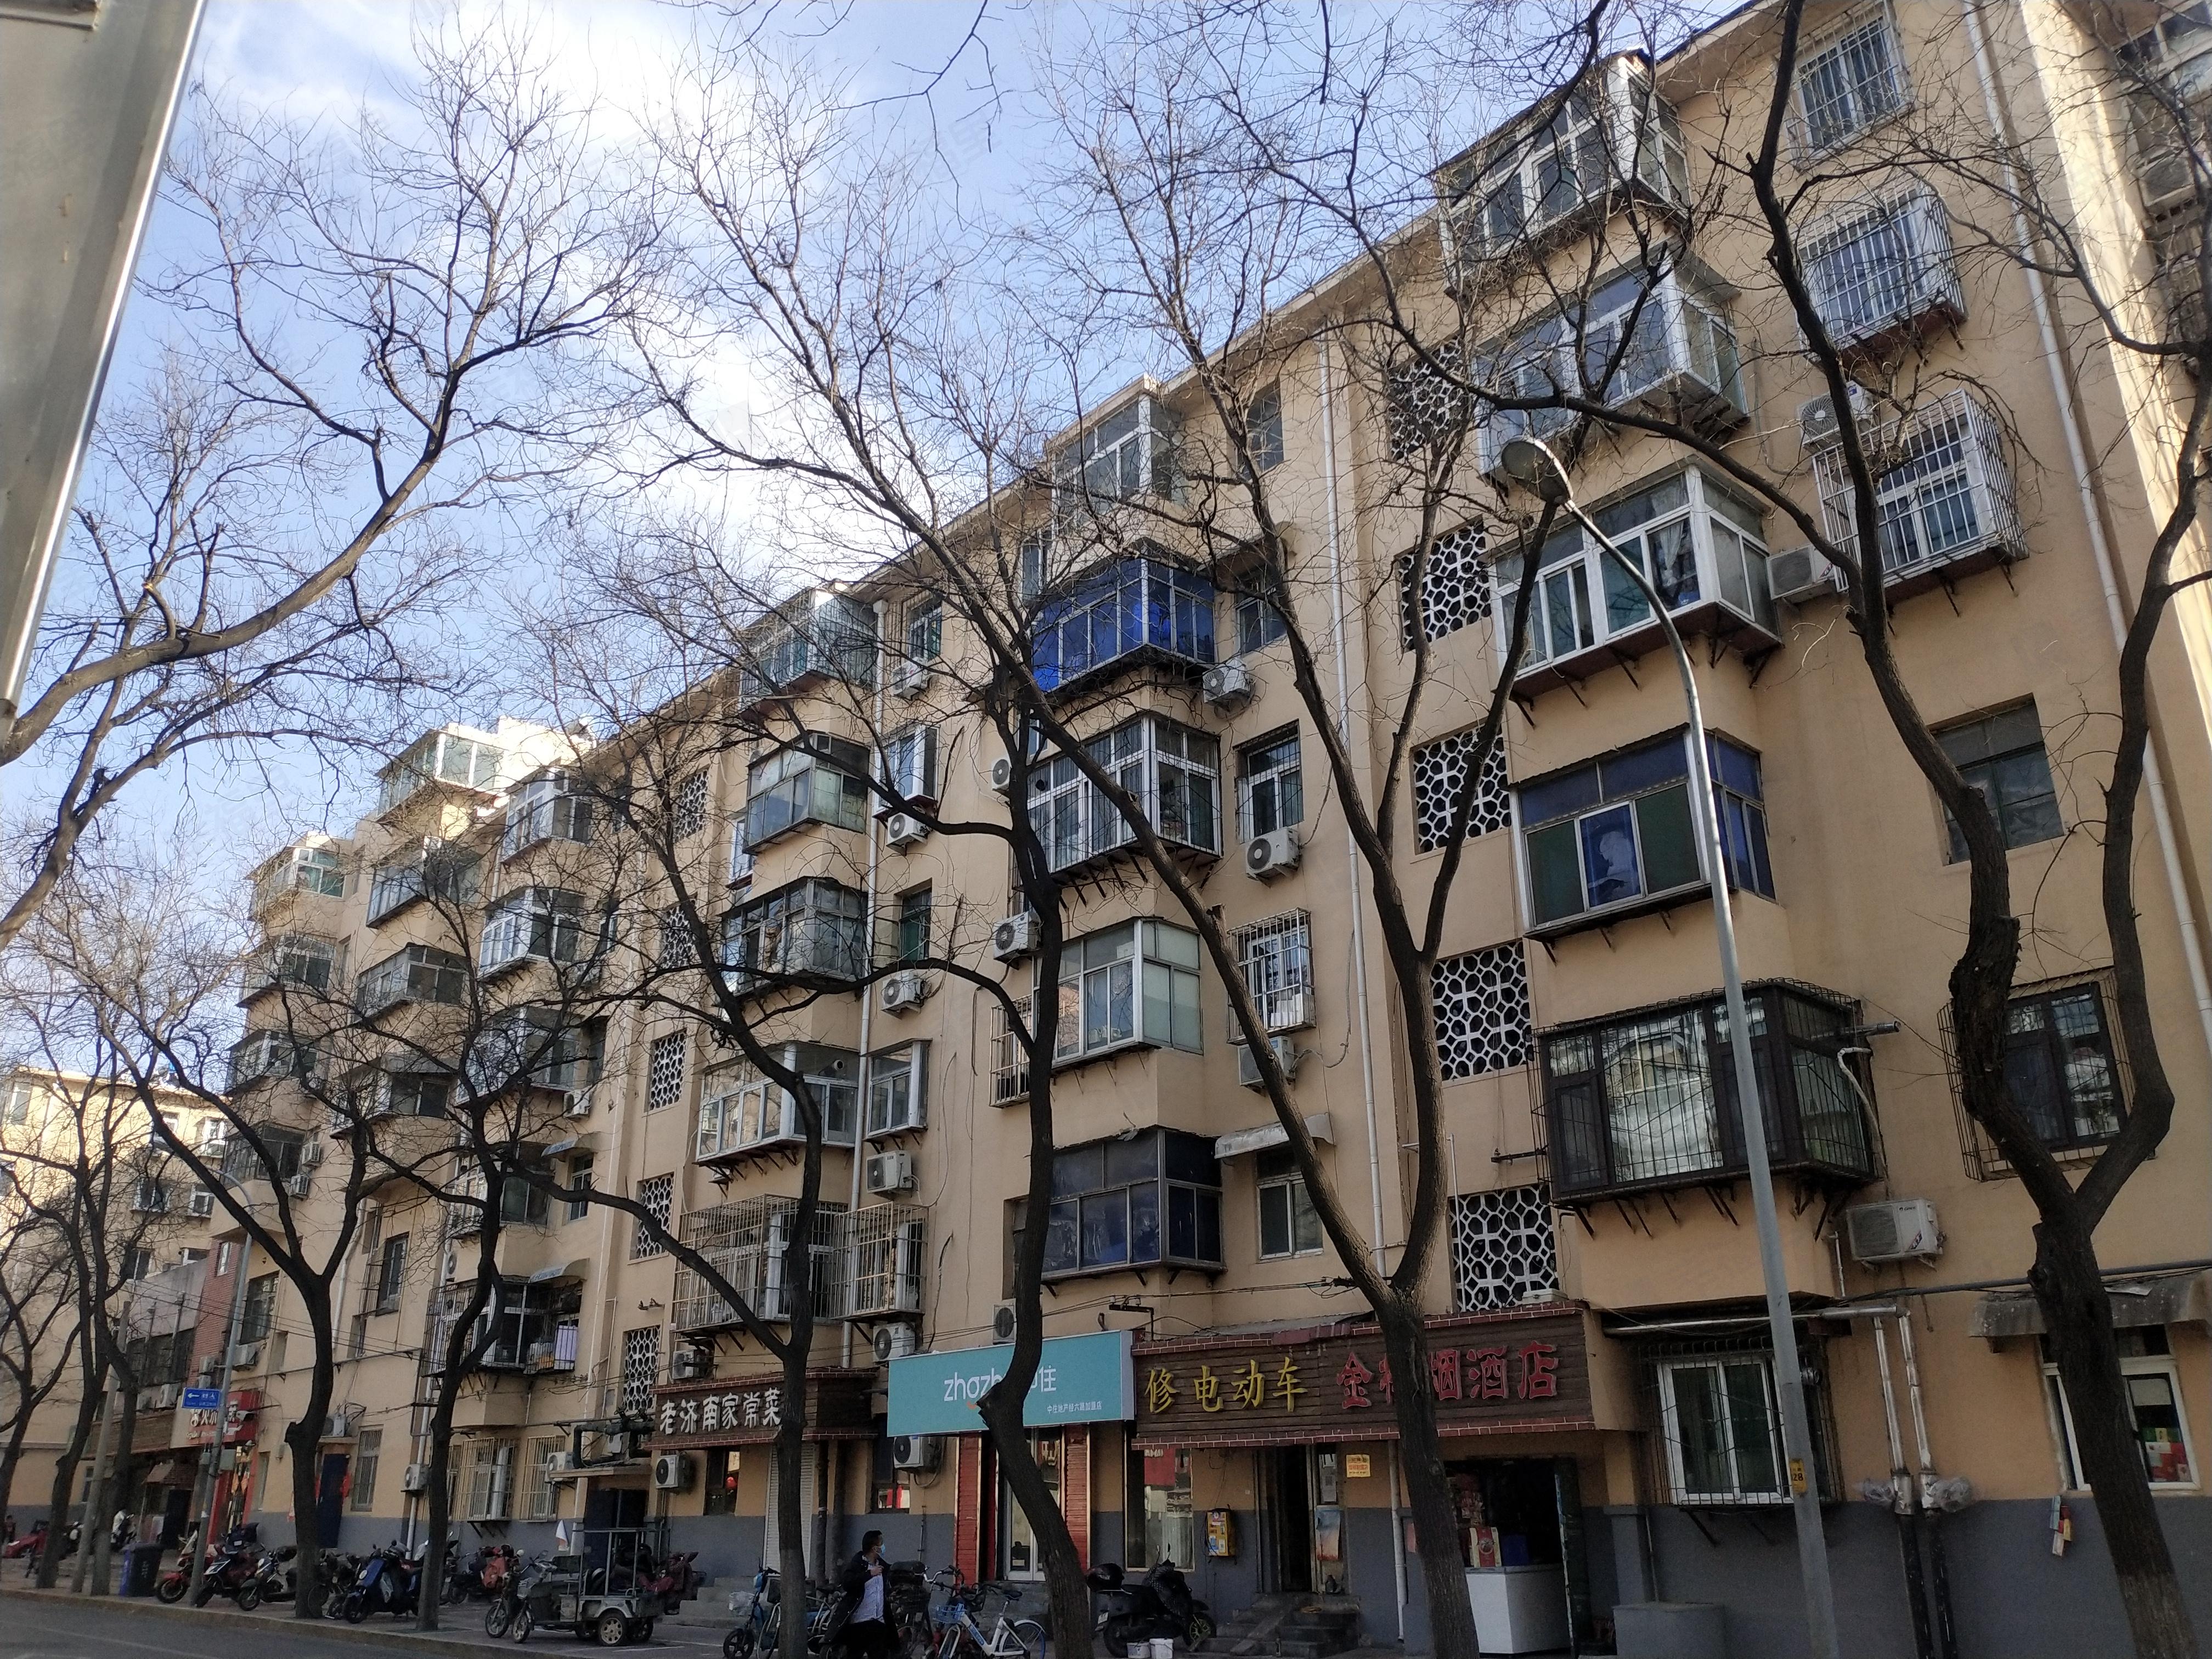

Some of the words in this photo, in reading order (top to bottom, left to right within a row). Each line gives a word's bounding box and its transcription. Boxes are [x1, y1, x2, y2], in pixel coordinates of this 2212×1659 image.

[1144, 1357, 1309, 1413] 修电动车
[1336, 1340, 1559, 1409] 金烟酒店
[660, 1387, 781, 1435] 老济南家常菜
